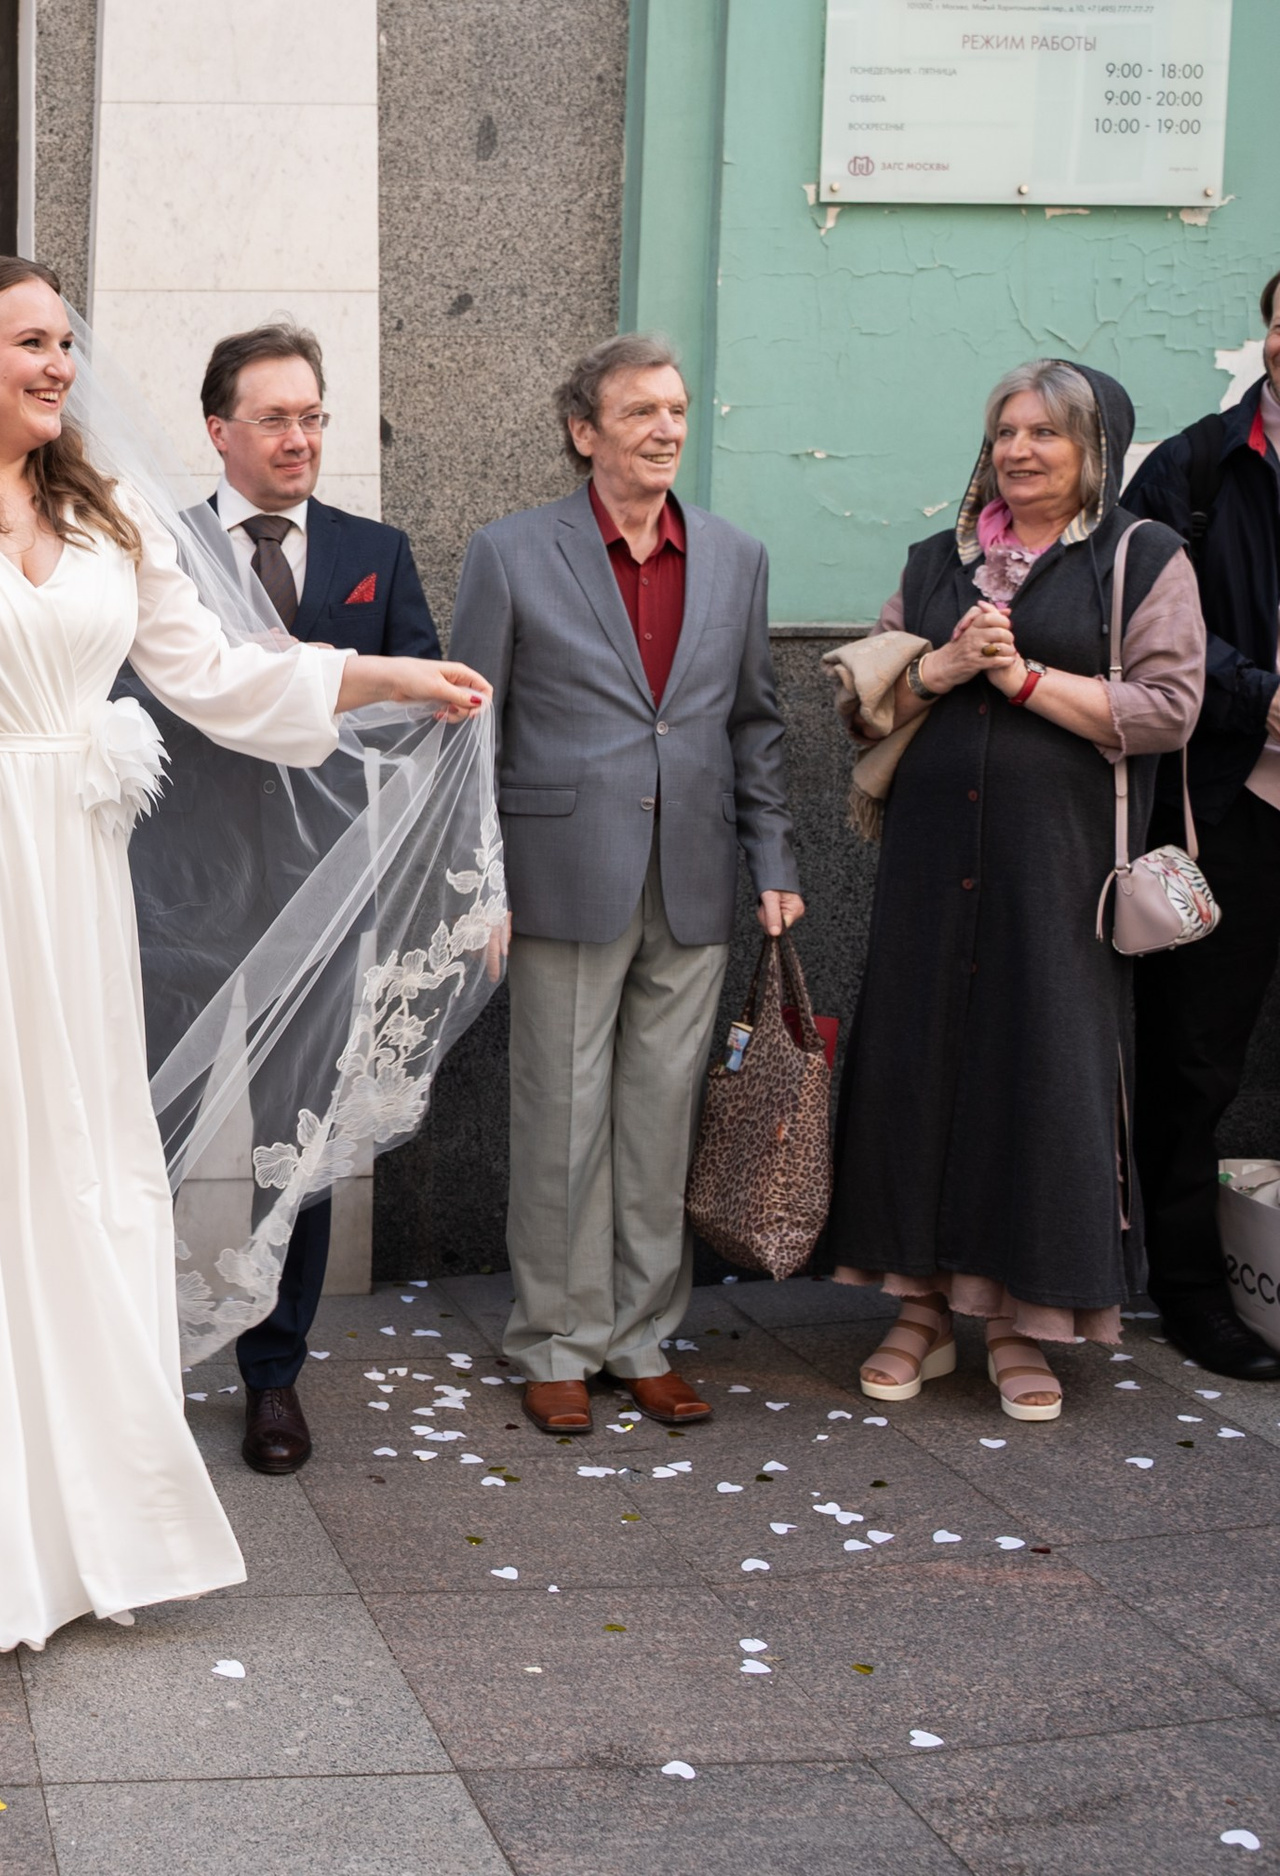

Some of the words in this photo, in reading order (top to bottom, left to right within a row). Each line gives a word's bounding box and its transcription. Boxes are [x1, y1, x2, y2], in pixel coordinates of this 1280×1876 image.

[962, 34, 1025, 50] РЕЖИМ
[1031, 35, 1097, 51] РАБОТЫ
[850, 66, 912, 76] ПОНЕДЕЛЬНИК
[918, 67, 957, 77] ПЯТНИЦА
[1105, 62, 1143, 79] 9:00
[1161, 63, 1204, 79] 18:00
[849, 94, 886, 103] СУББОТА
[1104, 90, 1141, 106] 9:00
[1156, 91, 1203, 107] 20:00
[848, 122, 905, 131] ВОСКРЕСЕНЬЕ
[1095, 118, 1140, 134] 10:00
[1157, 118, 1201, 135] 19:00
[880, 162, 904, 171] ЗАГС
[906, 162, 950, 171] МОСКВЫ
[1224, 1254, 1280, 1305] ecc
